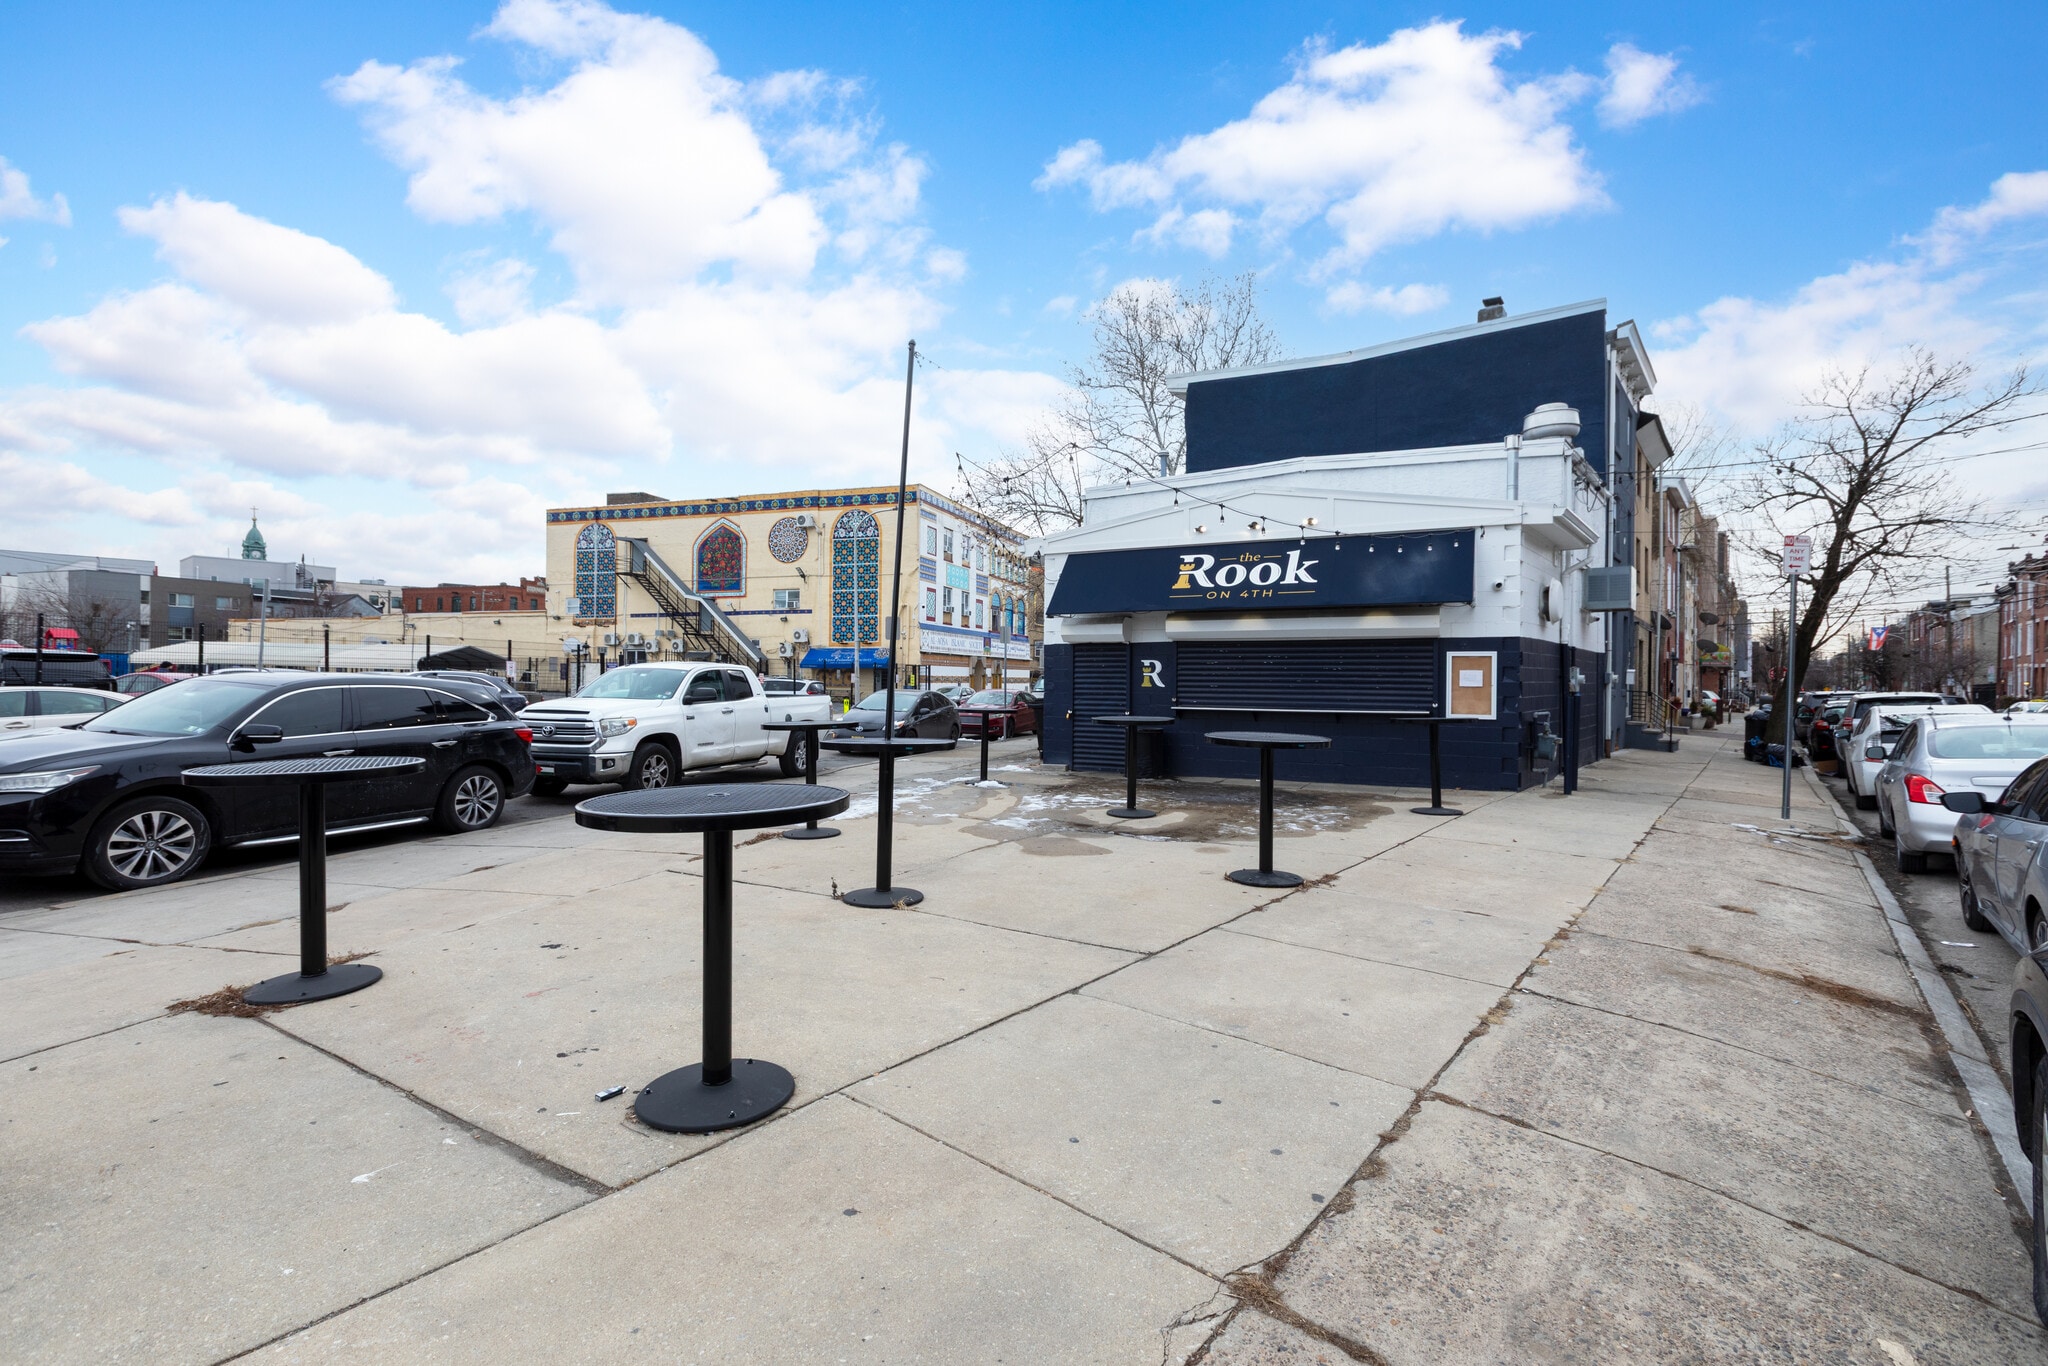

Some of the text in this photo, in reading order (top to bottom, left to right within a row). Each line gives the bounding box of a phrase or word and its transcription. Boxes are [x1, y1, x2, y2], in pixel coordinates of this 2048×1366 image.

[1785, 537, 1794, 545] NO
[1239, 552, 1262, 563] the
[1171, 549, 1319, 590] Rook
[1206, 589, 1274, 600] ON 4TH
[1140, 659, 1166, 688] R
